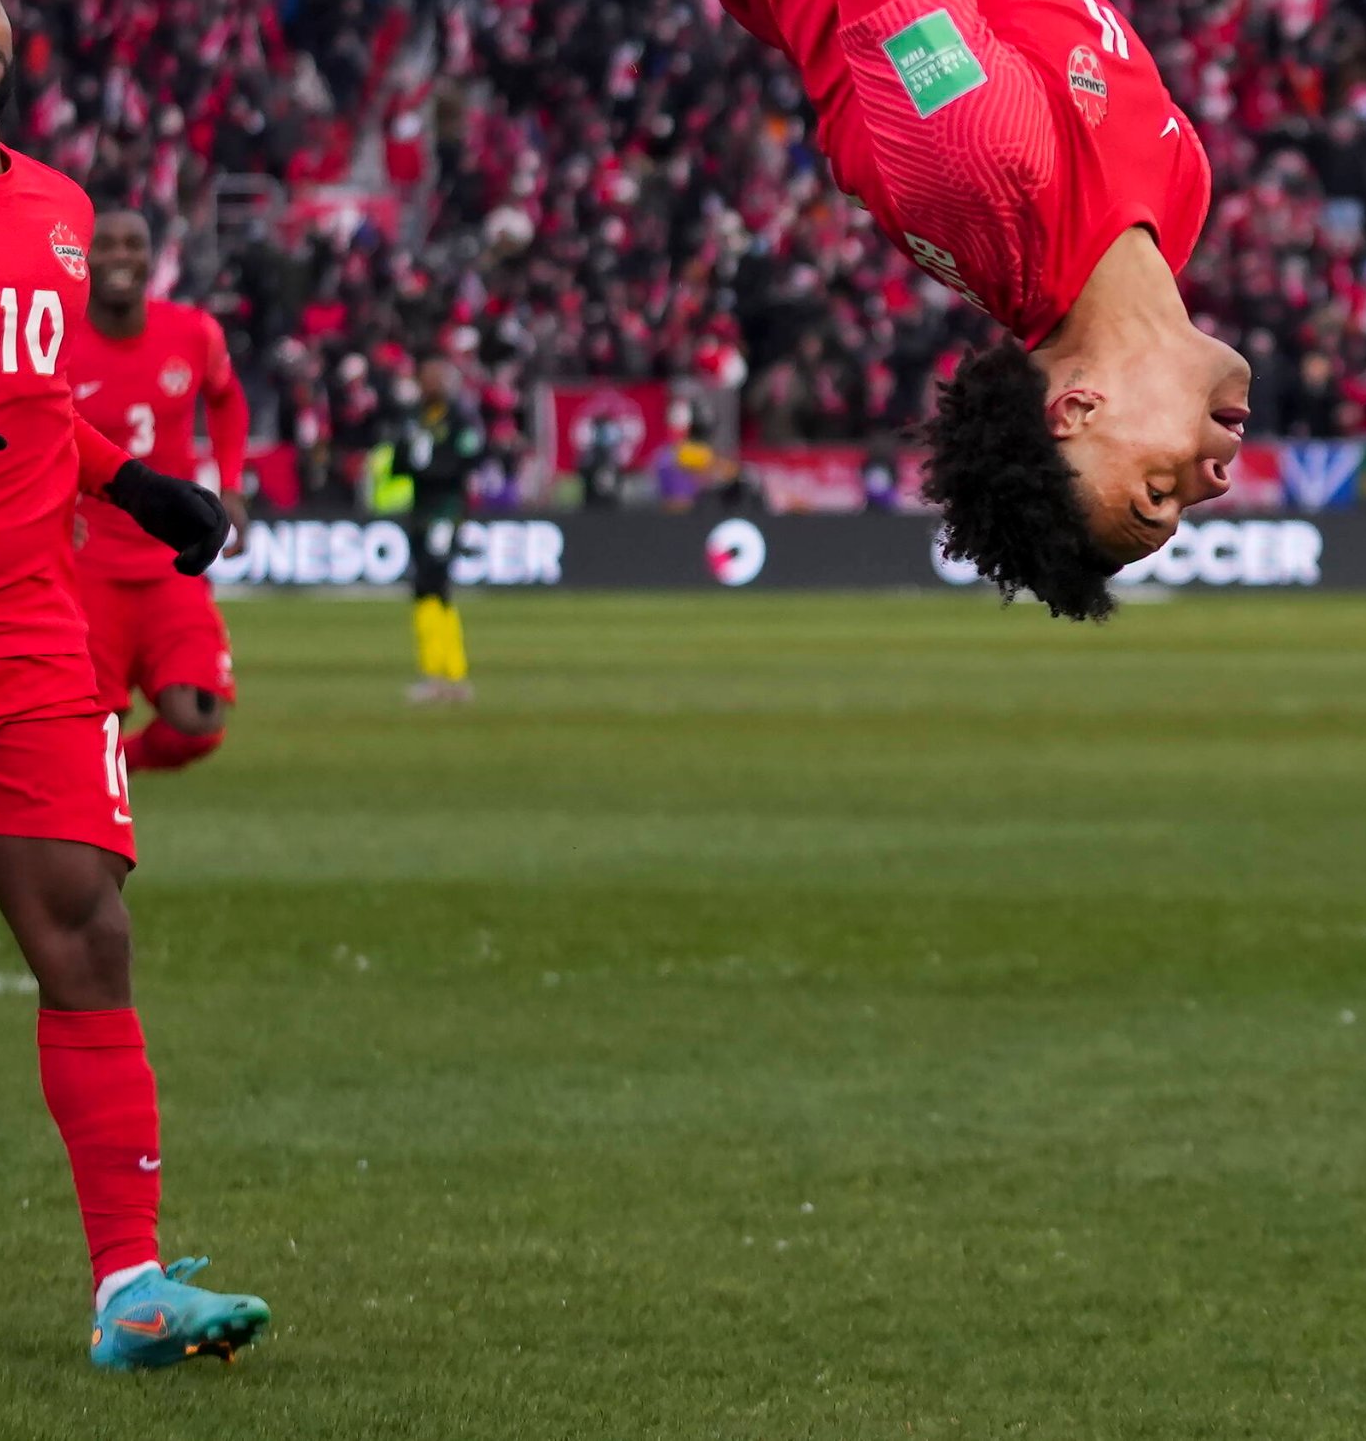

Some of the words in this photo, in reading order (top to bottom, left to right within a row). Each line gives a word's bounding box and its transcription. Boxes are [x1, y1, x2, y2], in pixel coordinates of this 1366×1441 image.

[1070, 72, 1107, 96] CANADA
[0, 287, 65, 376] 10
[126, 402, 156, 457] 3
